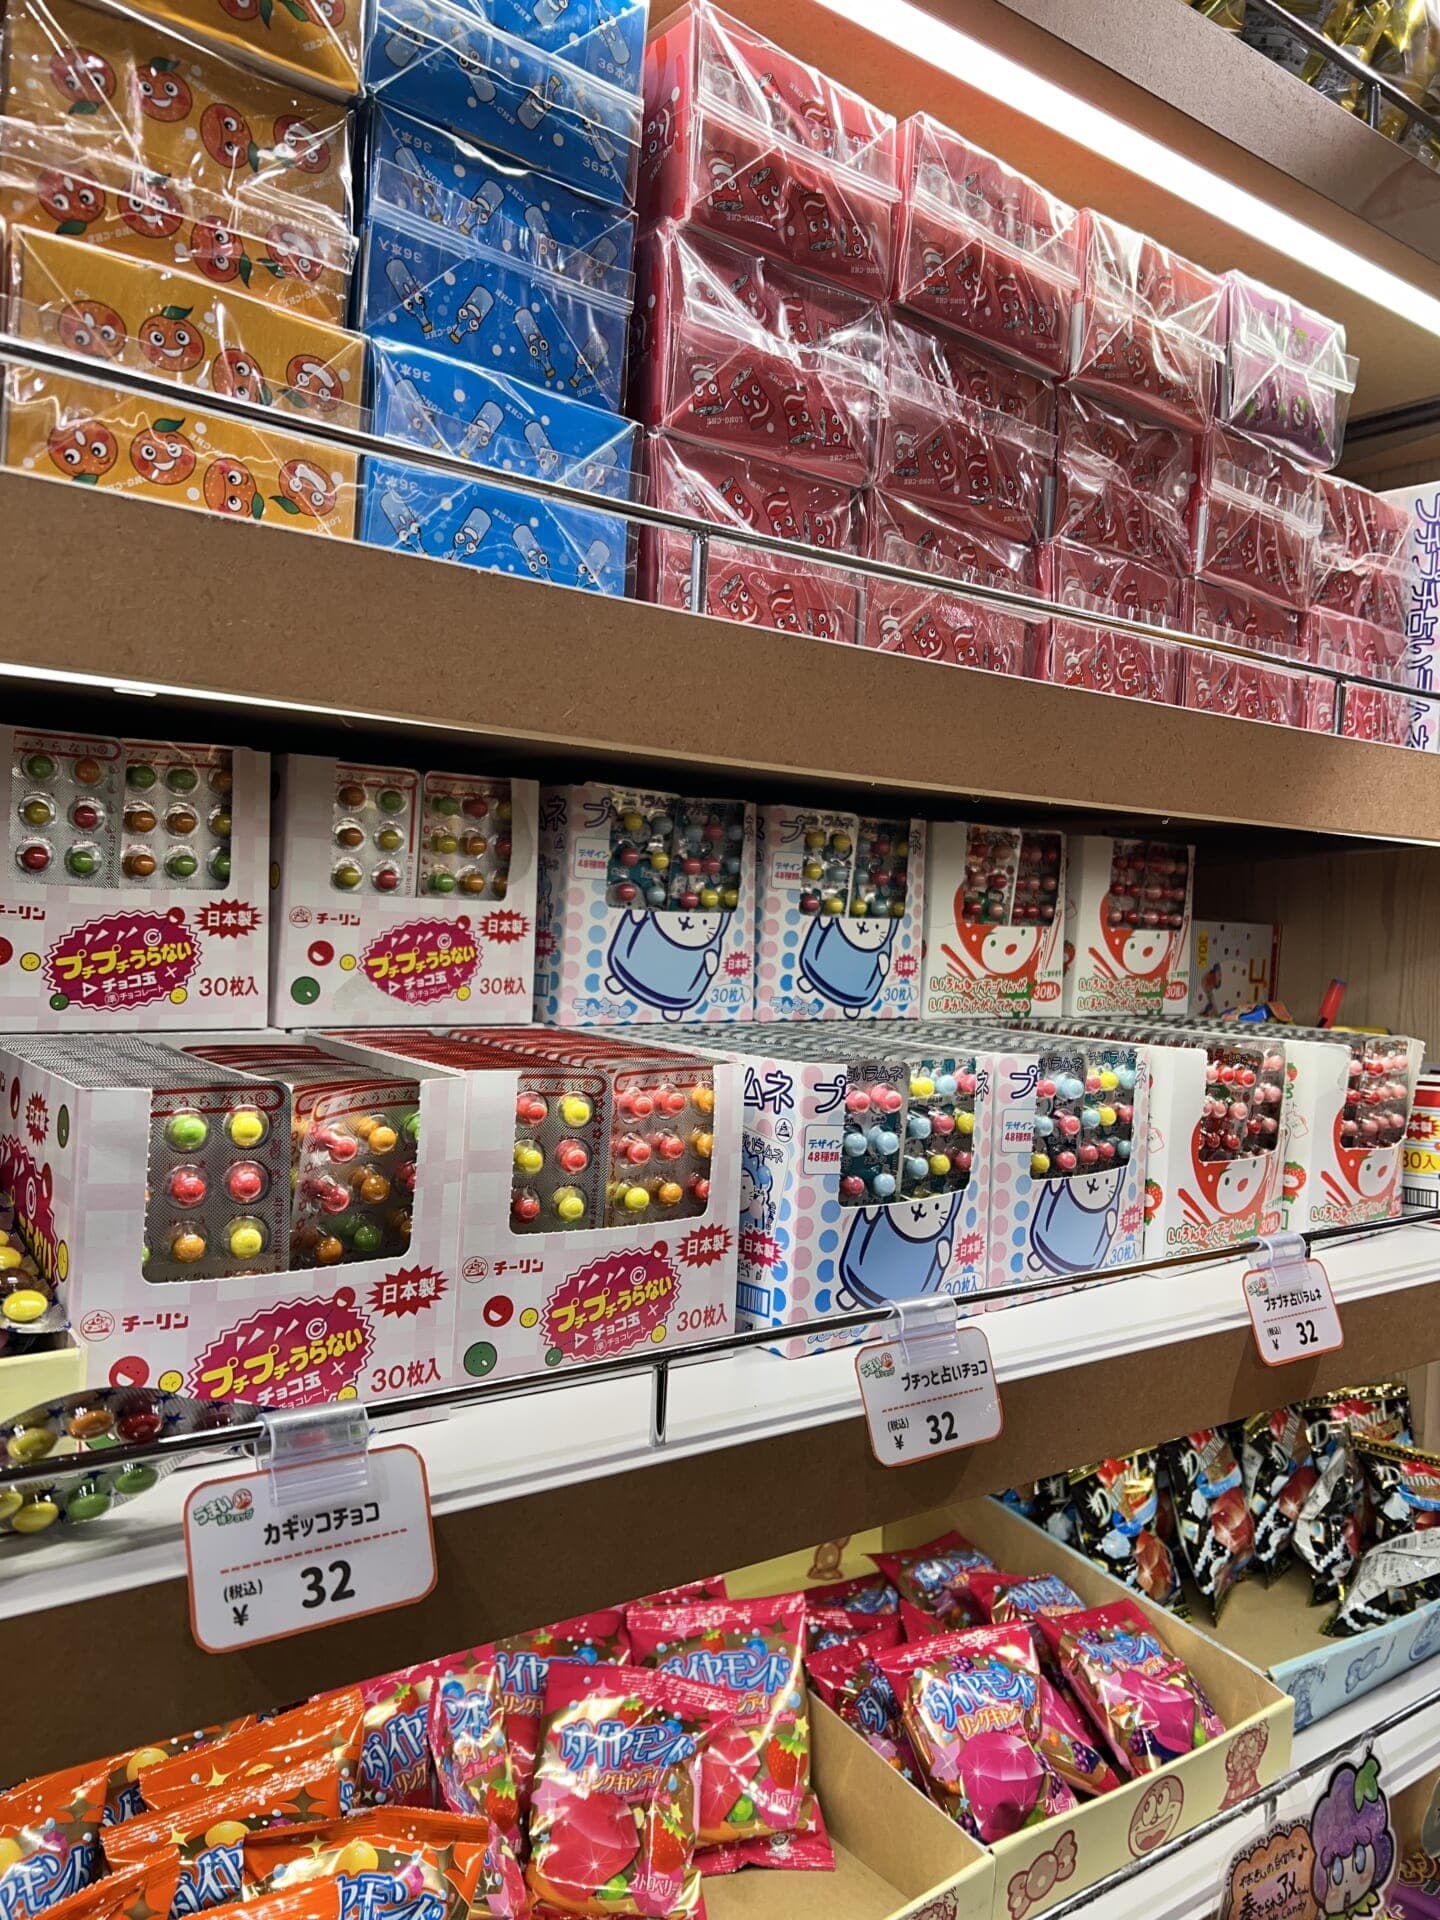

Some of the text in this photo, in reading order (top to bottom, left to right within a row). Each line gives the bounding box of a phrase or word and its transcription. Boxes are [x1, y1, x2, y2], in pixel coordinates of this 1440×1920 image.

[206, 910, 252, 928] 日本製
[316, 912, 361, 927] チーリン
[487, 918, 524, 935] 日本製
[55, 941, 192, 981] プチプチうらない
[101, 971, 158, 993] チョコ玉
[199, 975, 260, 998] 30枚入
[403, 971, 448, 991] チョコ玉
[479, 977, 527, 996] 30枚入
[710, 988, 746, 1004] 30枚入
[807, 1138, 842, 1151] デザイン
[807, 1151, 840, 1163] 48種類
[686, 1234, 728, 1255] 日本製
[493, 1259, 544, 1276] チーリン
[381, 1277, 438, 1304] 日本製
[551, 1276, 673, 1334] プチプチうらない
[121, 1312, 190, 1334] チーリン
[592, 1311, 641, 1341] チョコ玉
[676, 1303, 728, 1332] 30枚入
[1295, 1319, 1319, 1346] 32
[201, 1326, 364, 1399] プチプチうらない
[371, 1358, 442, 1393] 30枚入
[901, 1359, 989, 1393] プチっと占いチョコ
[887, 1417, 910, 1433] (税込)
[926, 1410, 959, 1446] 32
[264, 1501, 381, 1546] カギッコチョコ
[222, 1578, 264, 1604] (税込)
[300, 1559, 356, 1610] 32
[560, 1719, 698, 1771] ダイヤモンド
